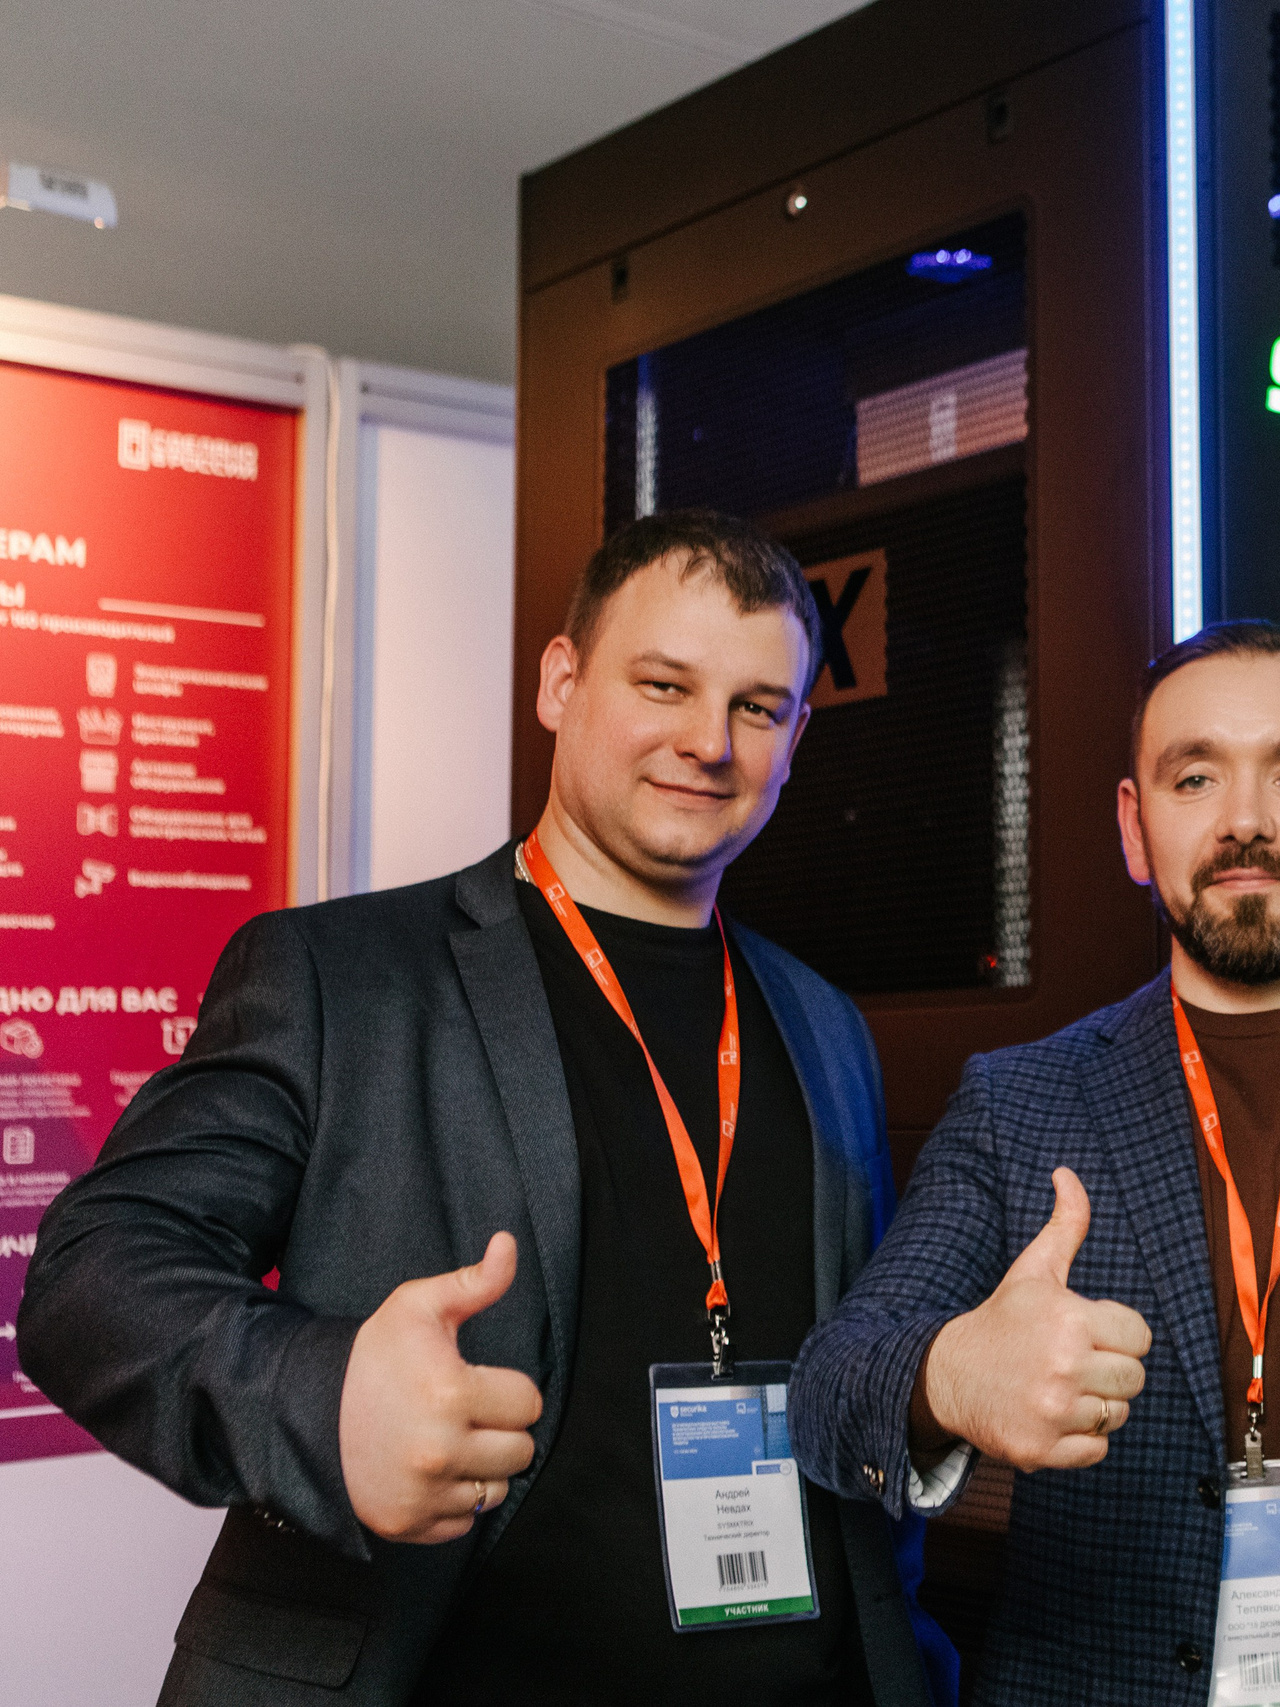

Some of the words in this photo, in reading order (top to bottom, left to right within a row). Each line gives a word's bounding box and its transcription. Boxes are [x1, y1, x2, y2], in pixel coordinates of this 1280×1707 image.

[56, 986, 117, 1015] ДЛЯ
[121, 986, 178, 1013] ВАС
[725, 1603, 769, 1617] УЧАСТНИК
